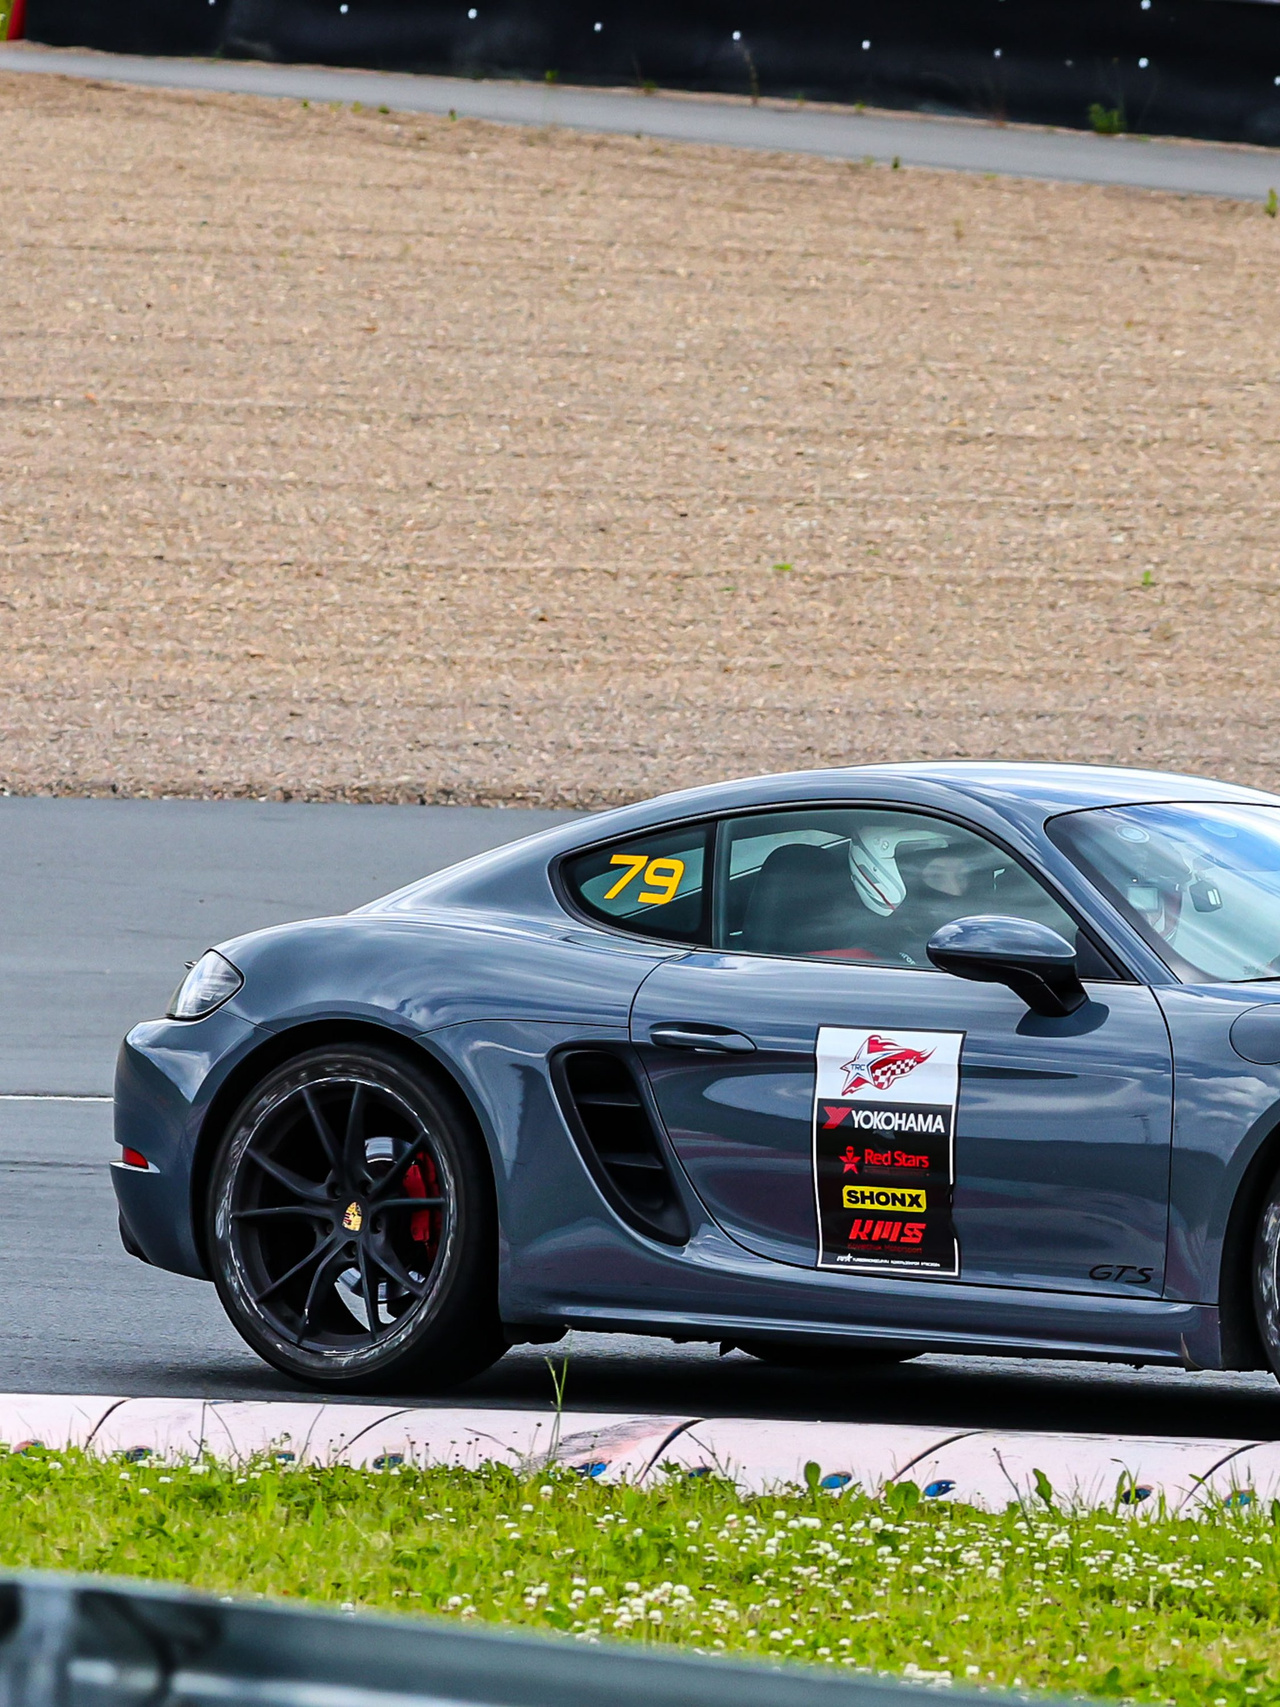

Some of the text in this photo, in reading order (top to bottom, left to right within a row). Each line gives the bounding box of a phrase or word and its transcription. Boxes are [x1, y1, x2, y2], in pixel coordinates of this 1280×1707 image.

[604, 854, 685, 904] 79
[850, 1063, 866, 1071] TRC
[851, 1110, 945, 1133] YOKOHAMA
[864, 1148, 930, 1168] Red Stars
[846, 1190, 923, 1208] SHONX
[1089, 1264, 1154, 1284] GTS
